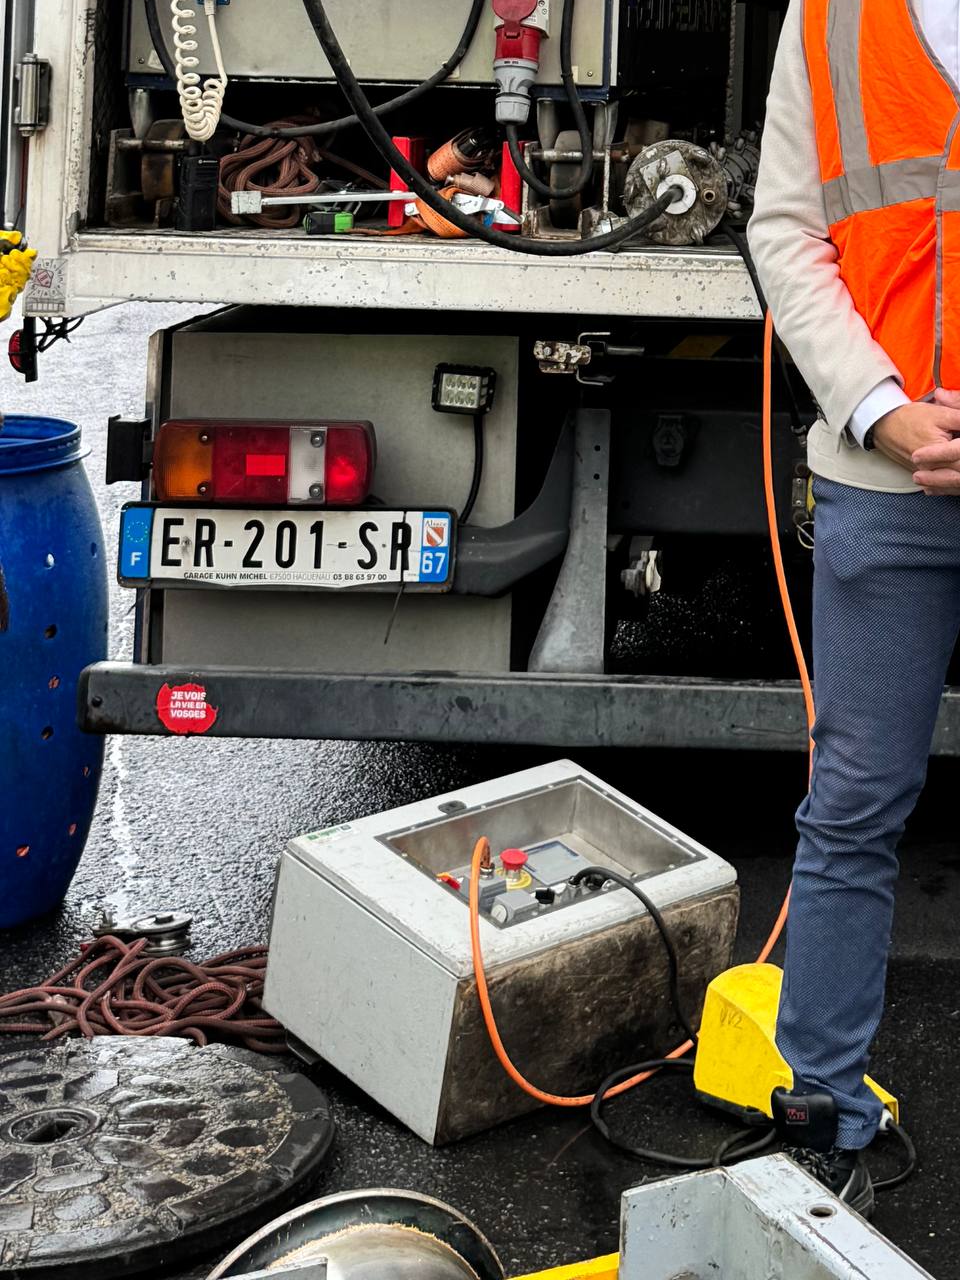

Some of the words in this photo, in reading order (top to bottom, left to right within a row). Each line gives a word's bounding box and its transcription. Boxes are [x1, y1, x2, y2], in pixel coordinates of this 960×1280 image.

[130, 551, 142, 567] F
[421, 551, 446, 575] 67
[183, 571, 213, 580] GARAGE
[215, 572, 238, 581] KUHN
[239, 572, 268, 581] MICHEL
[377, 573, 388, 581] 00
[170, 690, 184, 700] JE
[184, 691, 207, 701] VOIS
[170, 709, 207, 719] VOSGES
